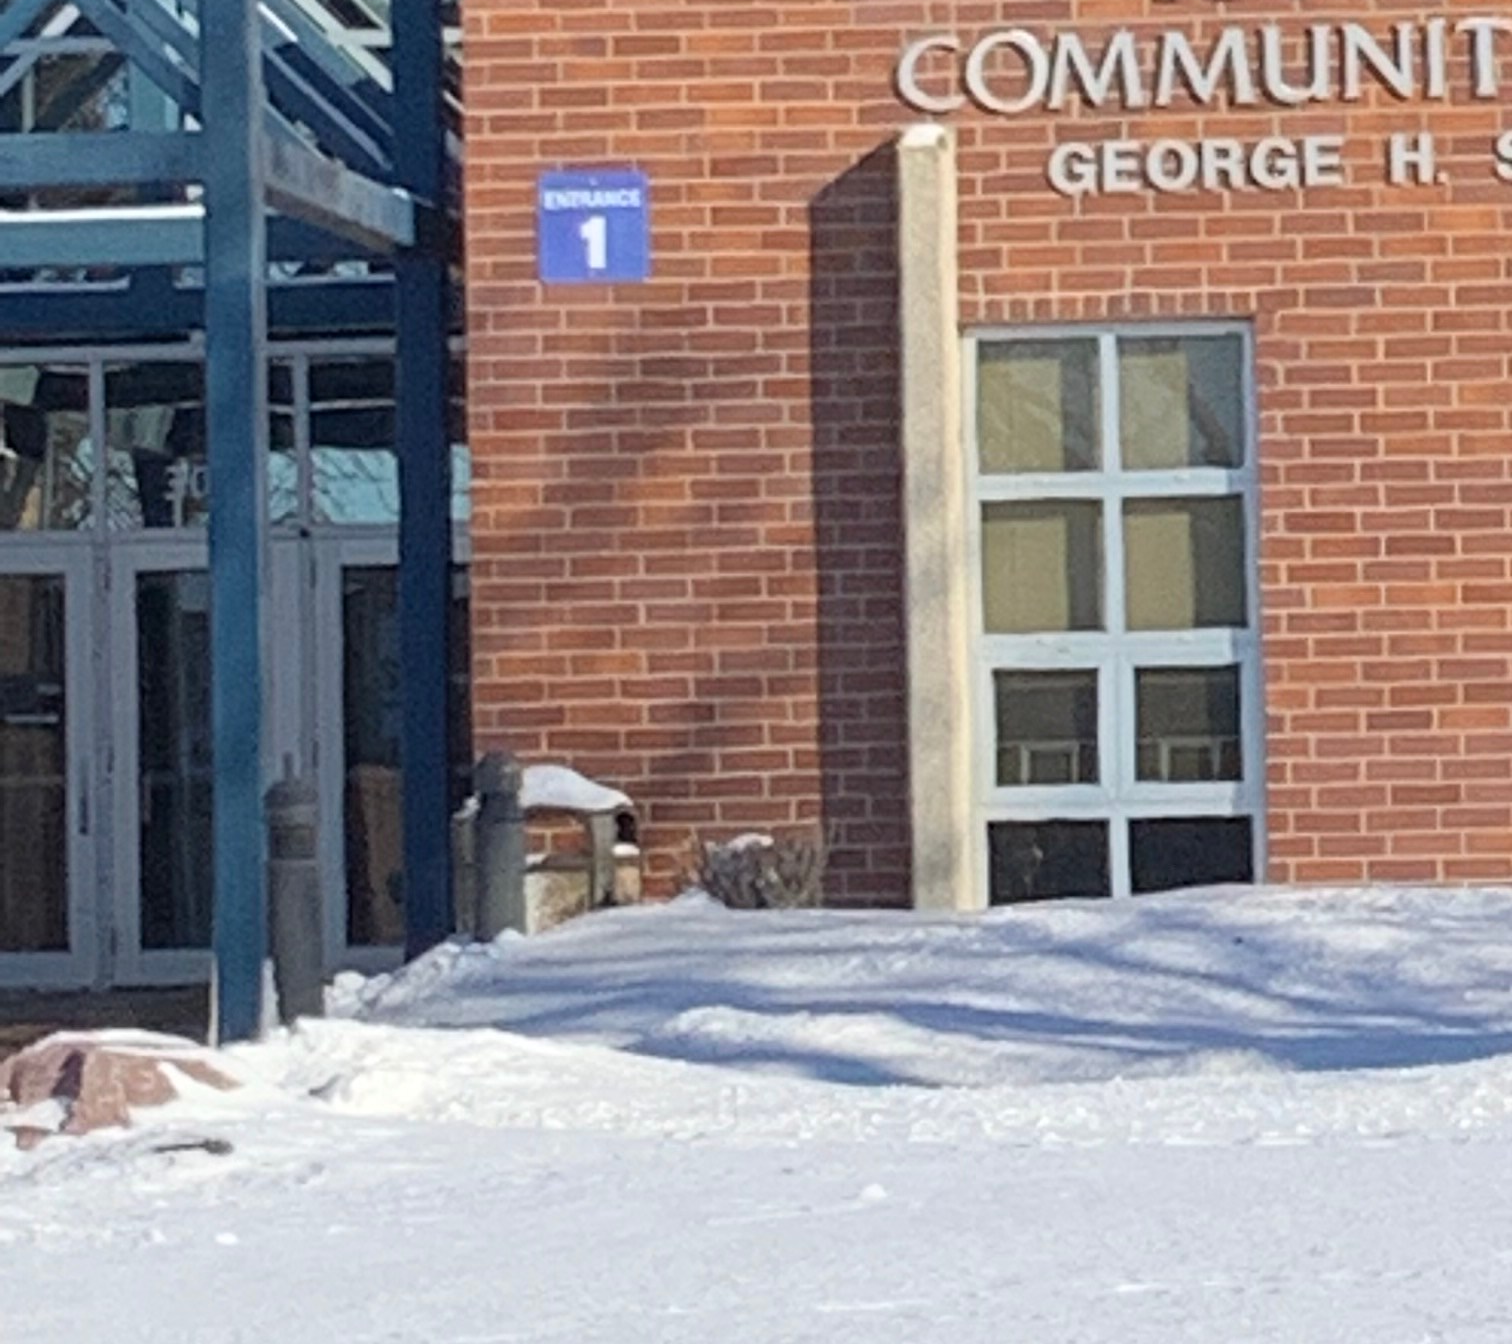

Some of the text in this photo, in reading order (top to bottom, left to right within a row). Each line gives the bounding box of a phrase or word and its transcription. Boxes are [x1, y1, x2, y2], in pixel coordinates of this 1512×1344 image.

[1047, 133, 1344, 195] GEORGE
[1388, 130, 1449, 185] H.
[580, 216, 607, 268] 1
